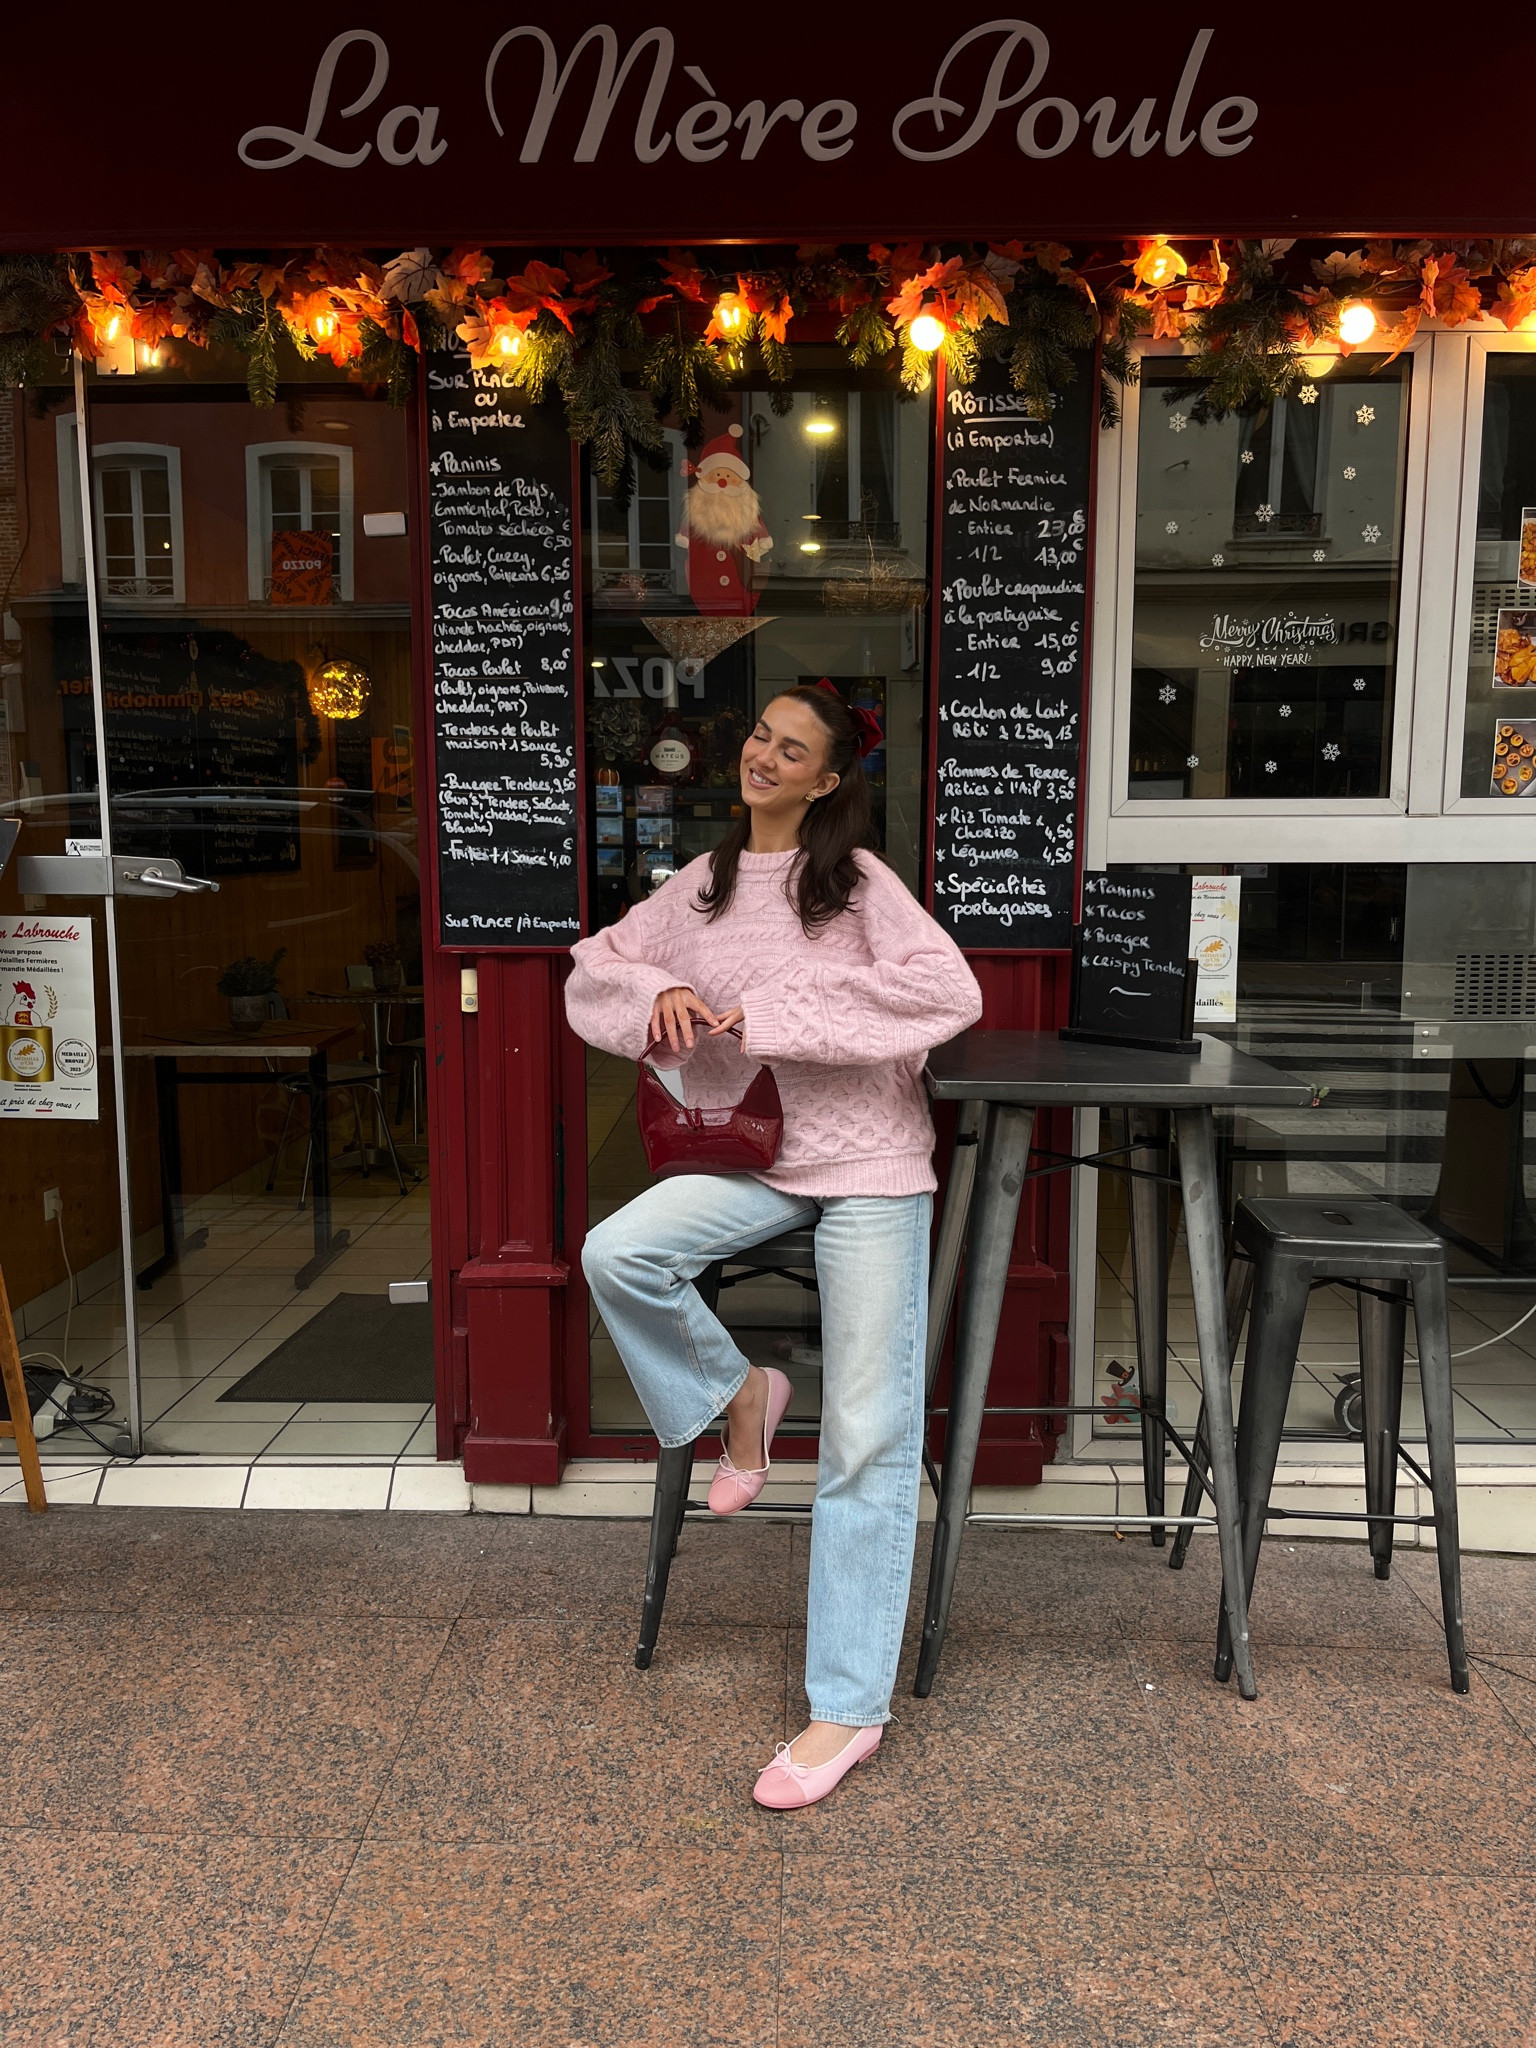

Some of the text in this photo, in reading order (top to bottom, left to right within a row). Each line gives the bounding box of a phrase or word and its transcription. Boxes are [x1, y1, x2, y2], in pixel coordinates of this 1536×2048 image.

[237, 19, 1259, 170] La Mère Poule
[432, 409, 443, 432] À
[952, 467, 1004, 489] Poulet
[494, 480, 512, 497] de
[948, 499, 967, 515] de
[438, 520, 493, 536] Tomates
[952, 573, 1004, 601] Poulet
[438, 603, 478, 619] Tacos
[944, 610, 956, 625] à
[958, 604, 976, 625] la
[1200, 613, 1335, 648] Merry Christmas
[439, 662, 479, 678] Tacos
[481, 657, 522, 676] Poulet
[1223, 654, 1253, 667] HAPPY
[1256, 654, 1278, 666] NEW
[950, 697, 1069, 720] Cochon de Lait
[500, 722, 518, 737] de
[520, 720, 560, 738] Poulet
[1001, 762, 1023, 779] de
[978, 807, 1031, 826] Tomate
[1096, 877, 1156, 900] Paninis
[1097, 904, 1147, 921] Tacos
[12, 921, 80, 941] Labrouche
[26, 957, 58, 965] Fermières
[1195, 998, 1224, 1007] daillés
[27, 1098, 37, 1106] de
